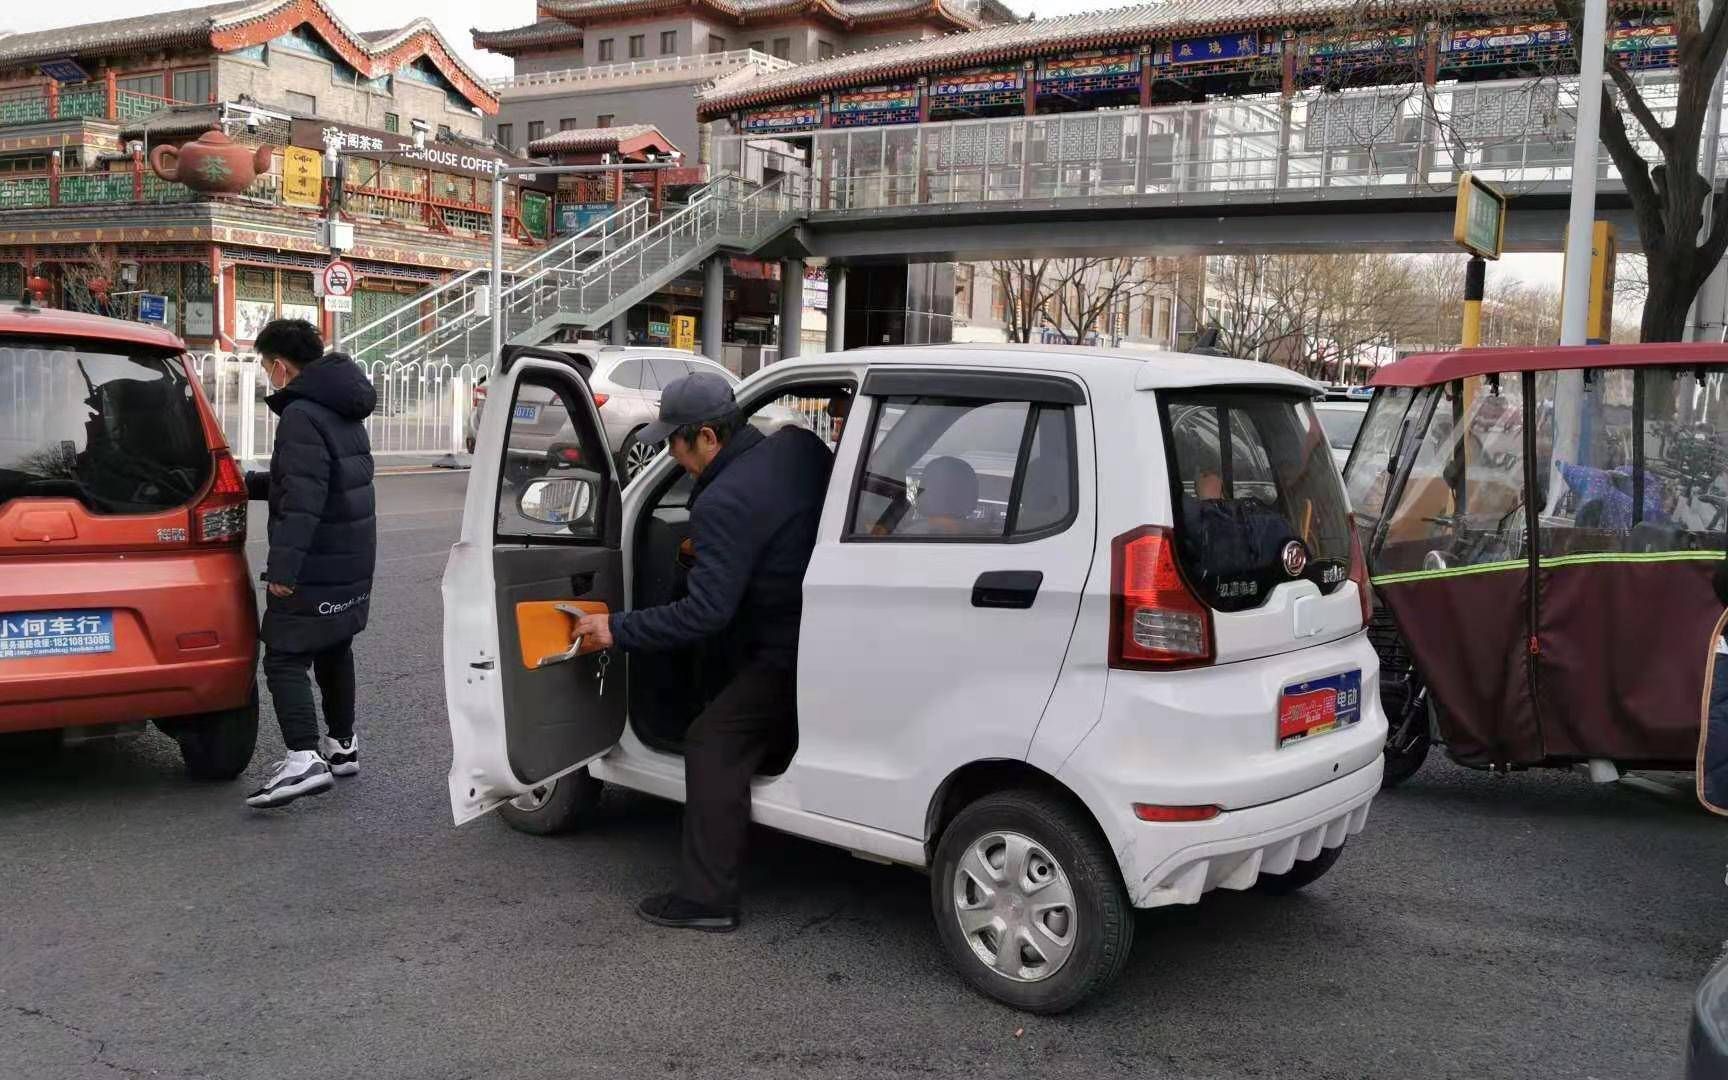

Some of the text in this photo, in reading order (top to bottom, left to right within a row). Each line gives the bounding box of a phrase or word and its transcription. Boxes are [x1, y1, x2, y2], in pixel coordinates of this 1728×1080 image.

[197, 155, 232, 181] 茶
[0, 615, 102, 638] 小何车行
[1337, 688, 1358, 707] 电动
